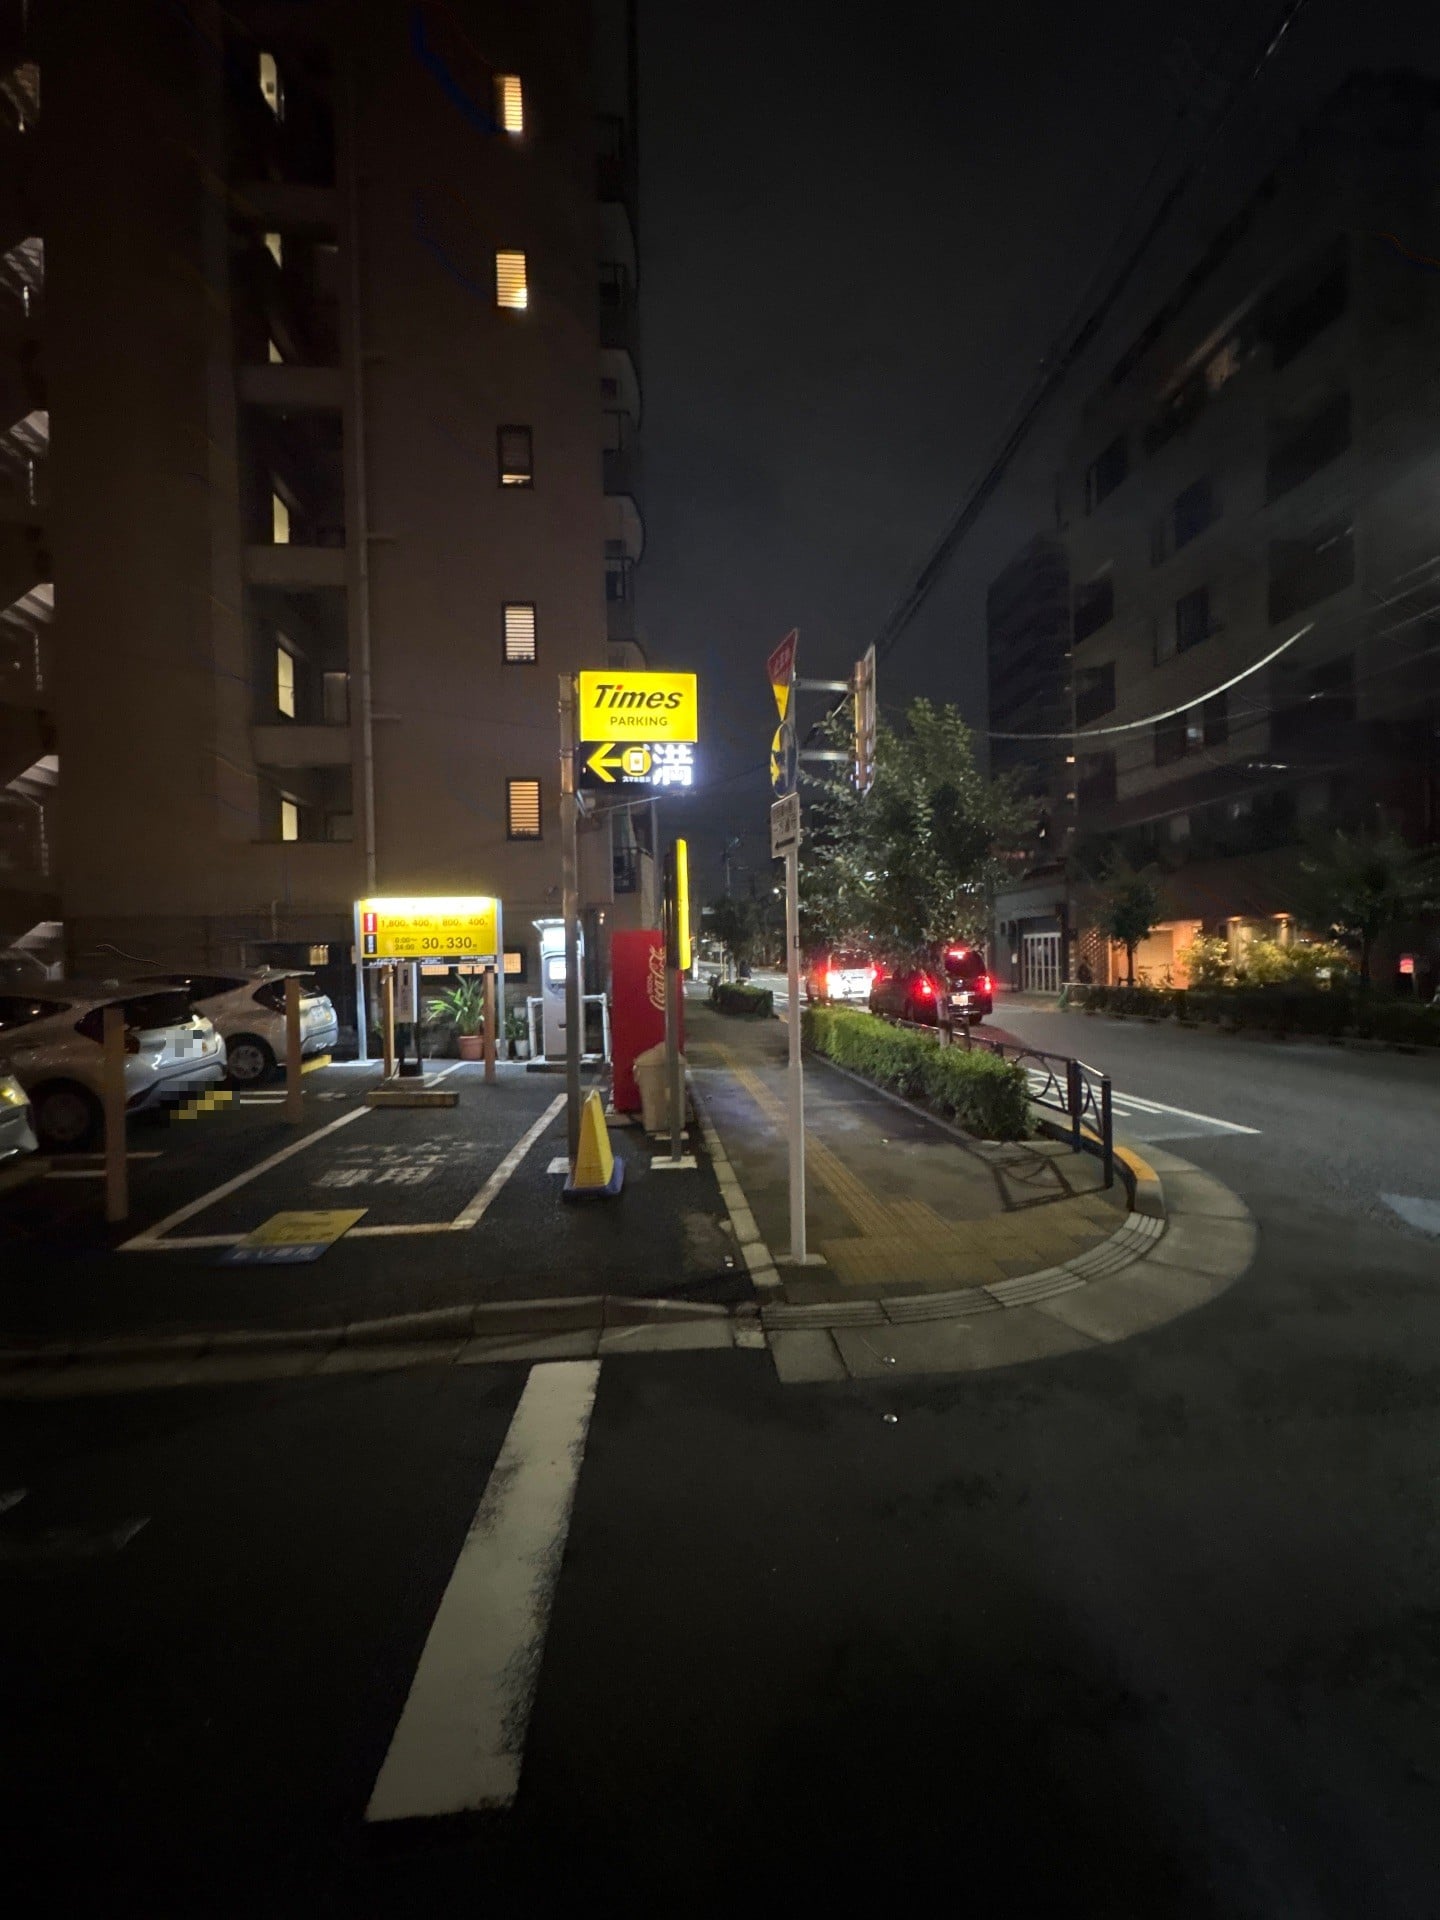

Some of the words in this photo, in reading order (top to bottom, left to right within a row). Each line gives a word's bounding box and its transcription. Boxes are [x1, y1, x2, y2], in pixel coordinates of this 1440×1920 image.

[594, 684, 684, 709] Times
[610, 716, 668, 726] PARKING
[651, 743, 694, 786] 満
